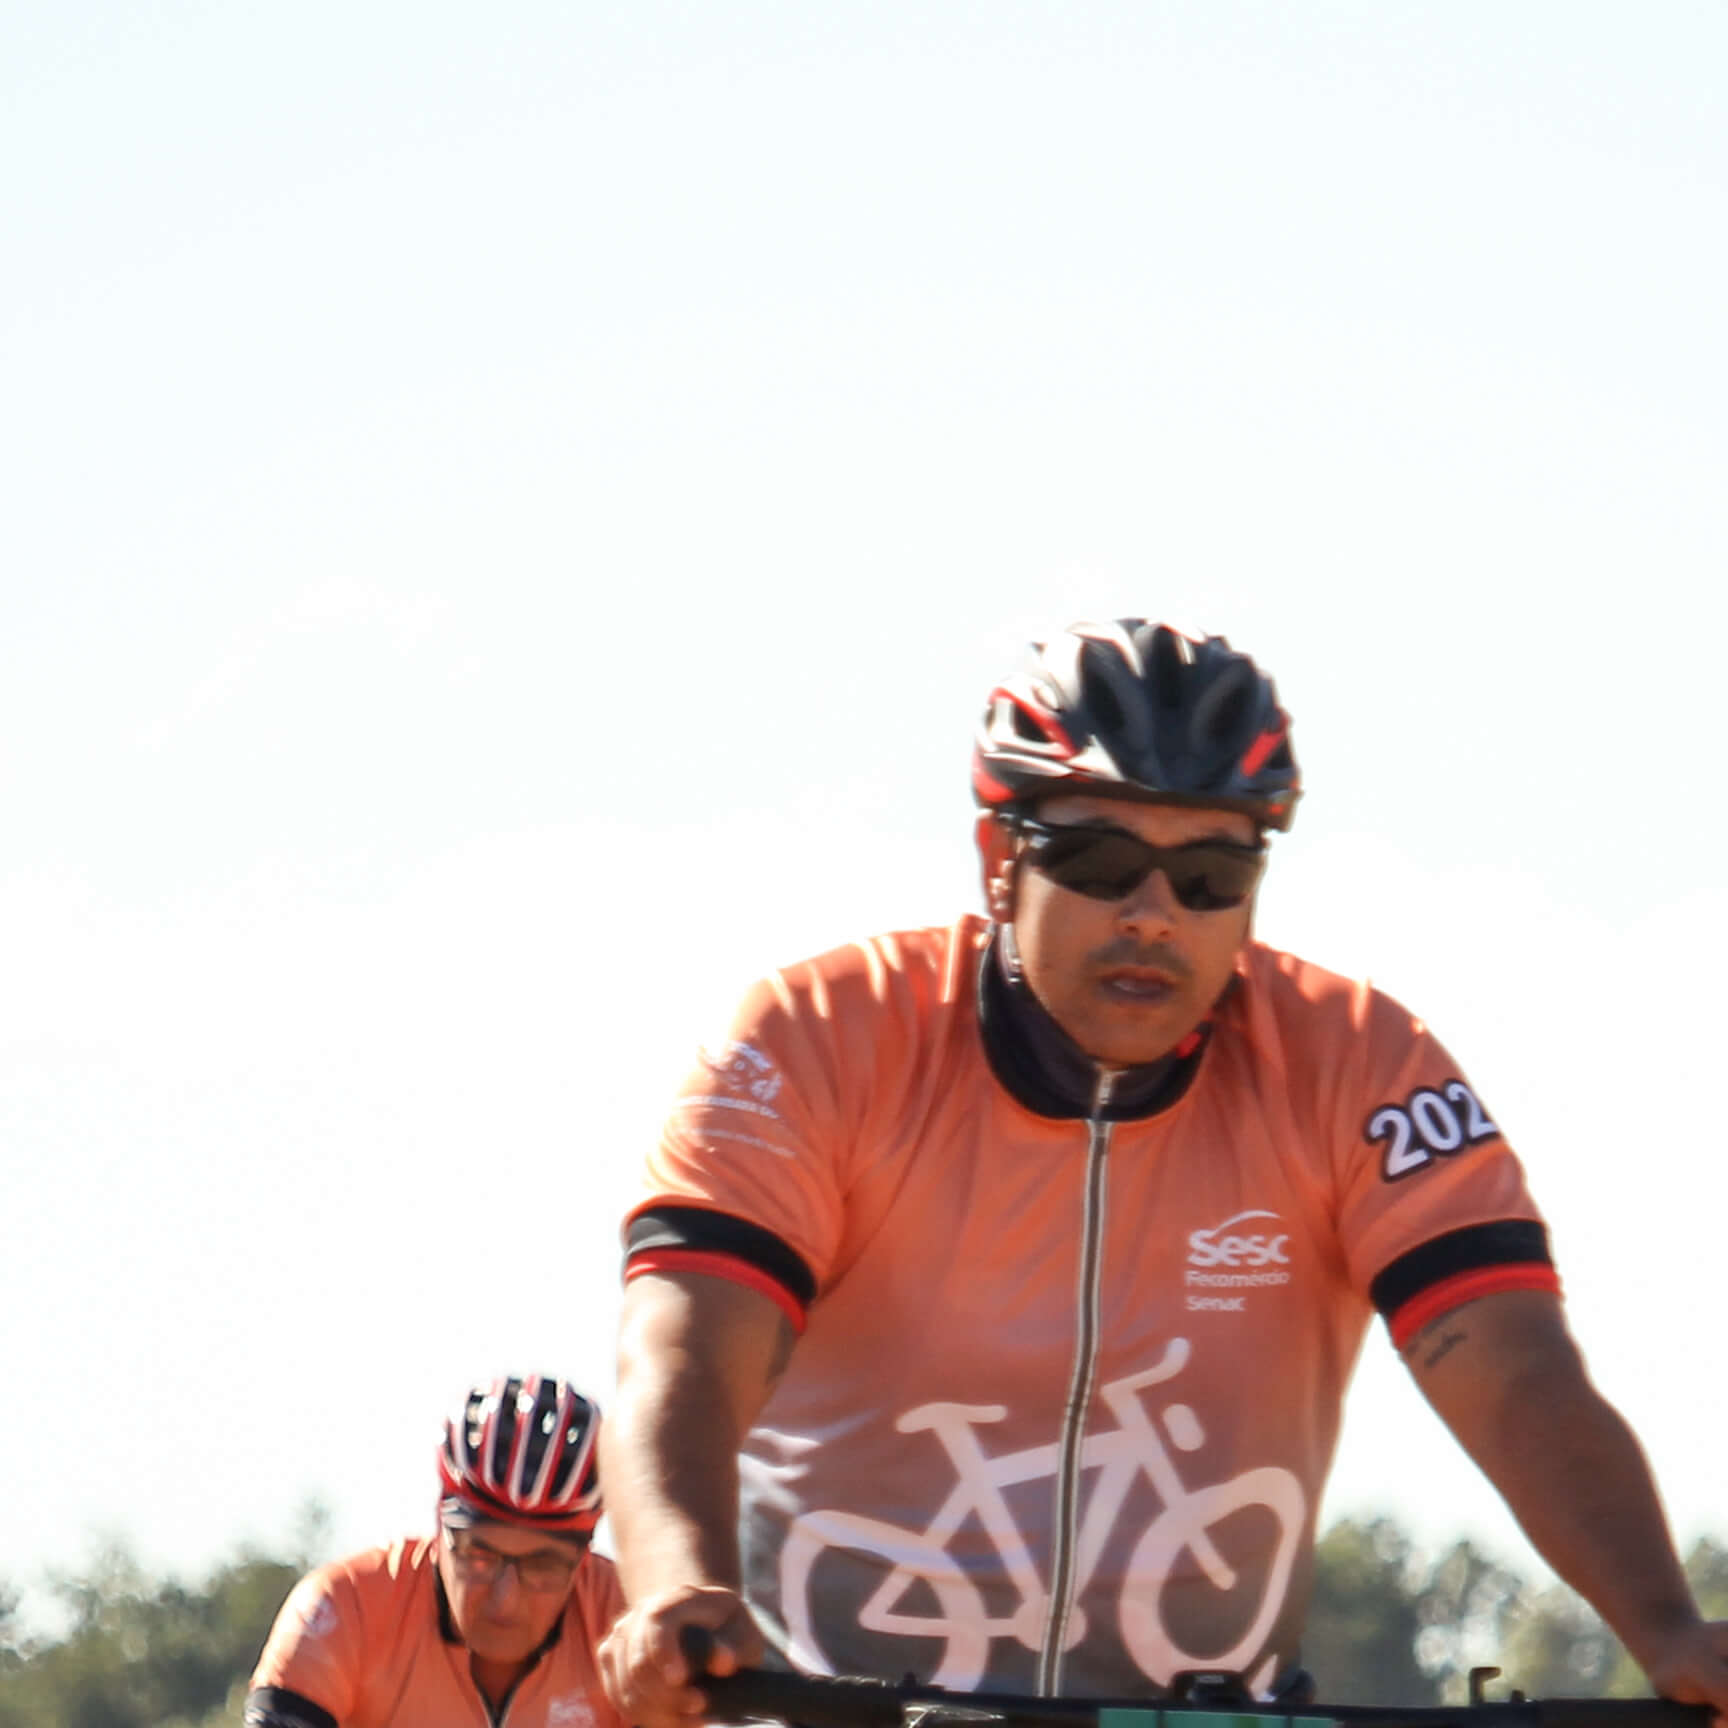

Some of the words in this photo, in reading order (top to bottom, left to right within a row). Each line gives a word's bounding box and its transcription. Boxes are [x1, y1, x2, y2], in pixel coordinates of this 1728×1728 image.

[1367, 1080, 1500, 1178] 202
[1187, 1224, 1291, 1267] Sesc
[1185, 1295, 1247, 1312] Senac
